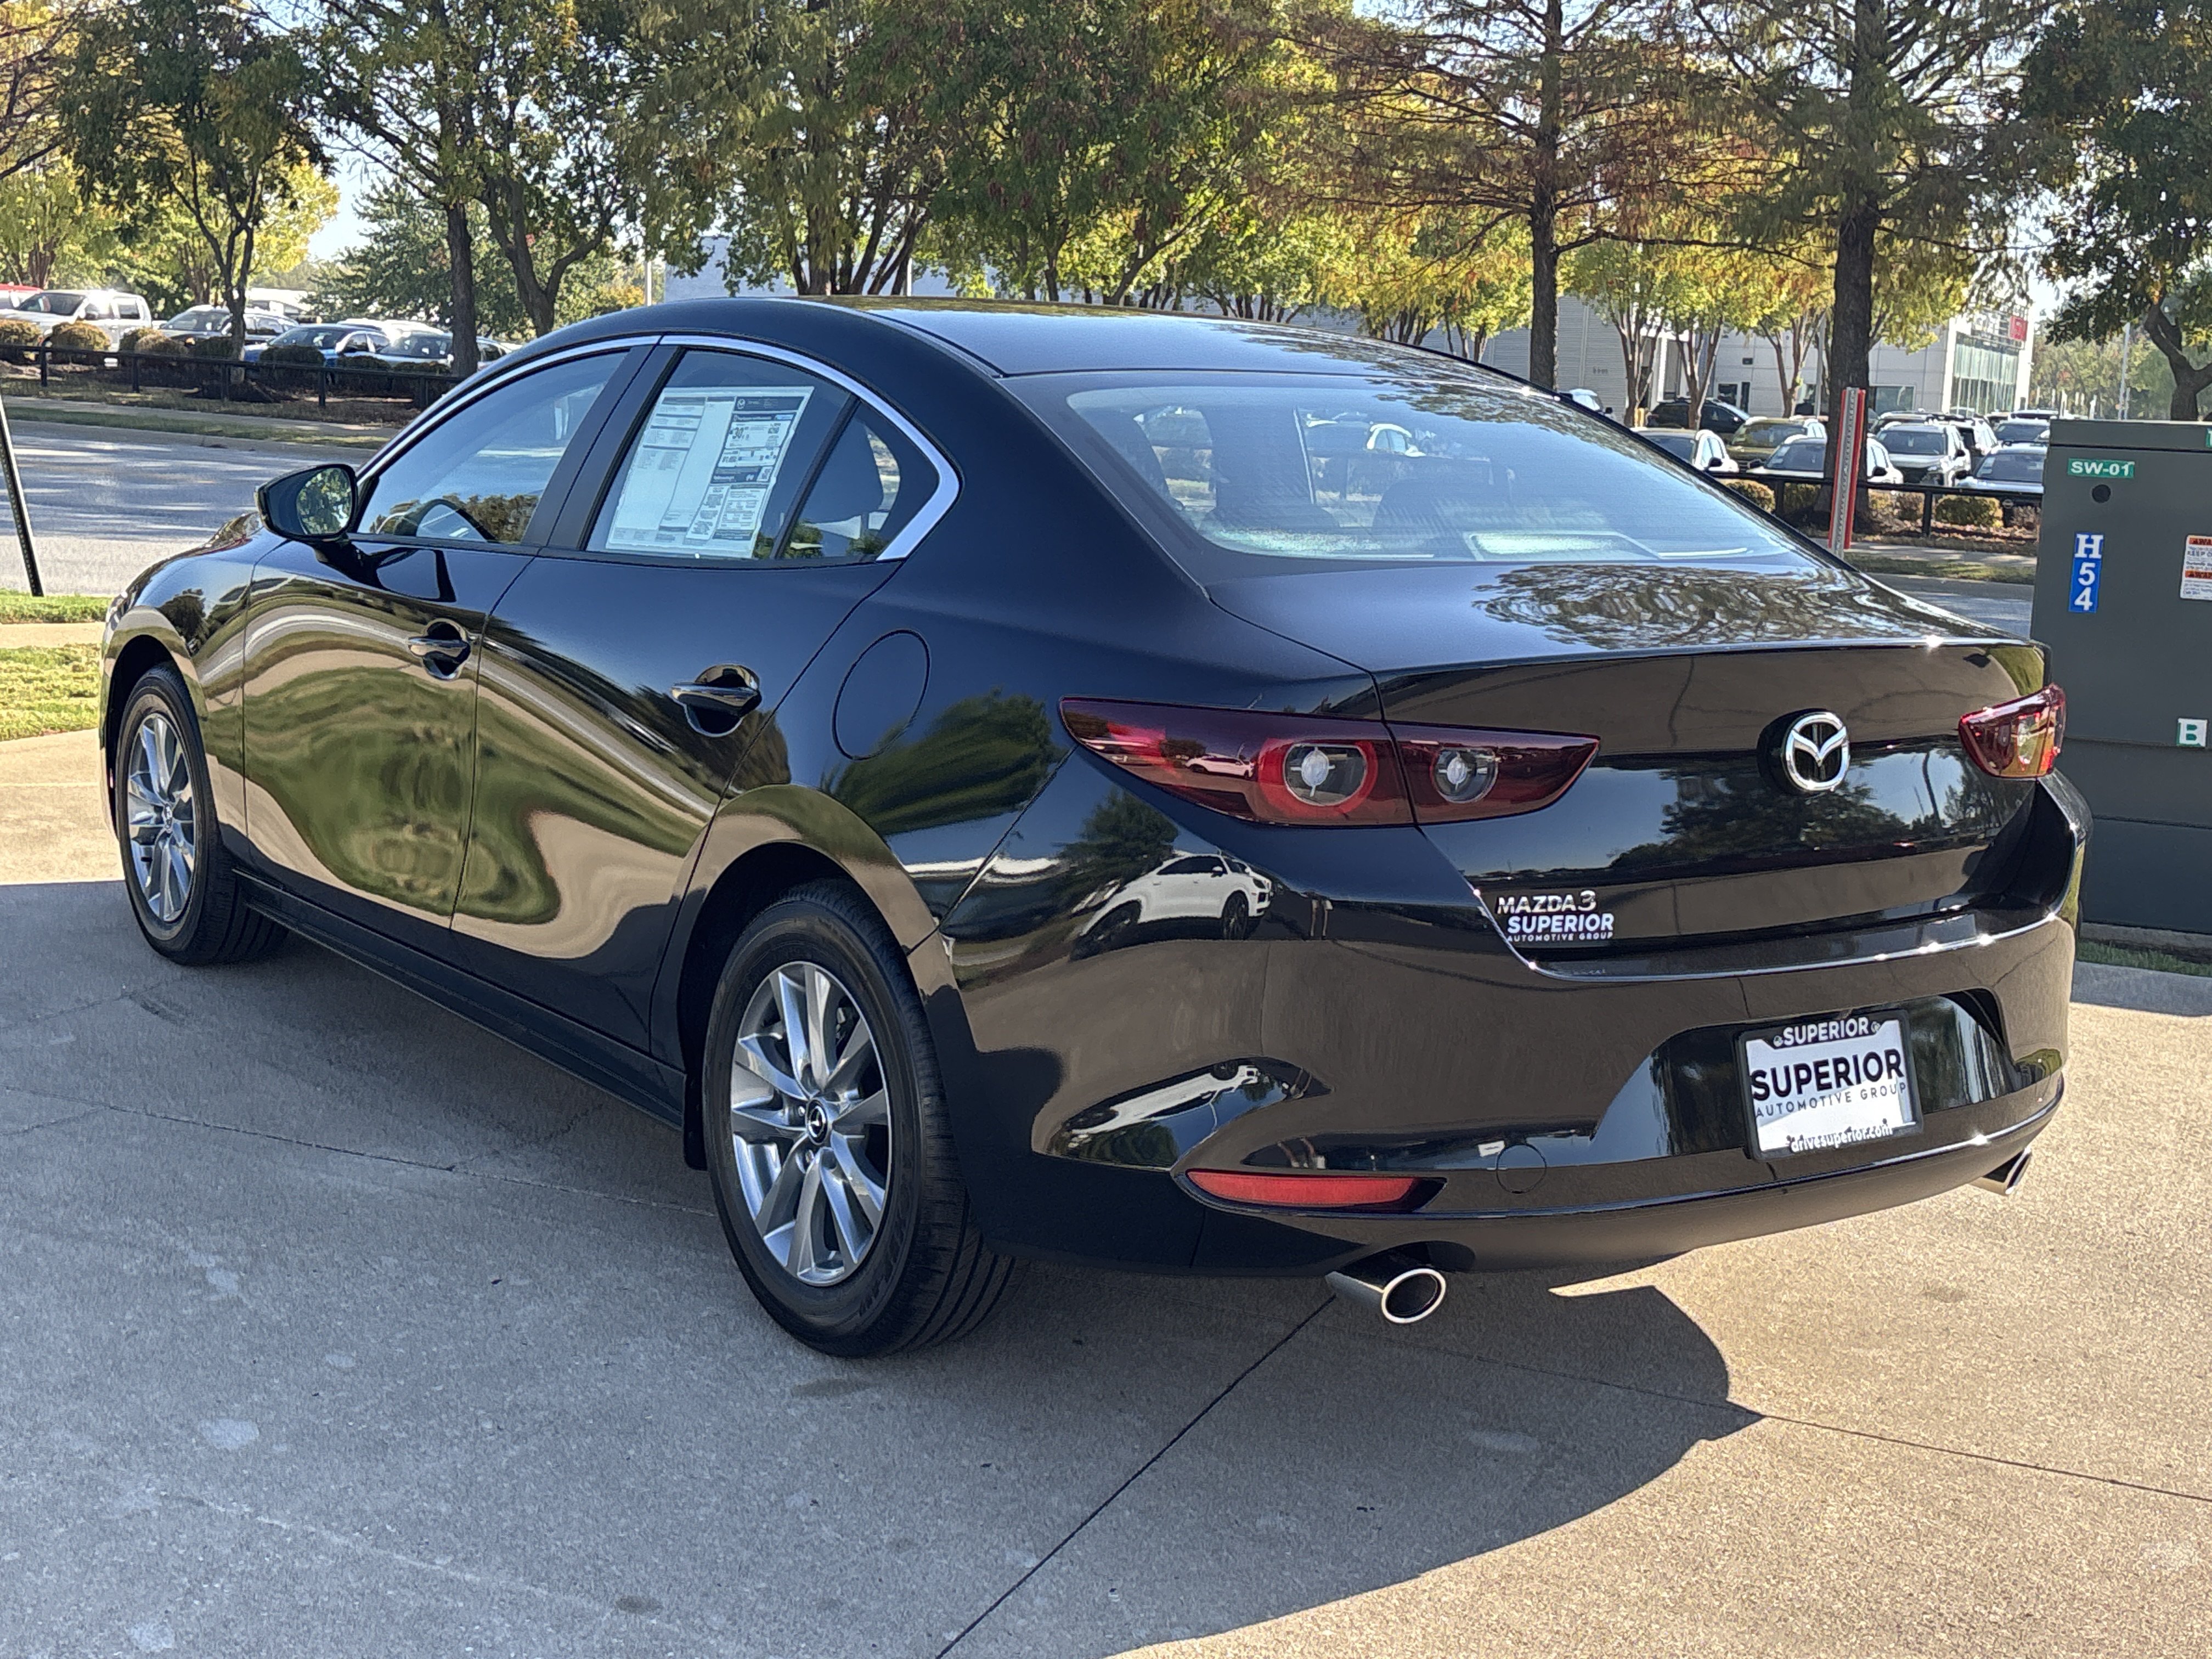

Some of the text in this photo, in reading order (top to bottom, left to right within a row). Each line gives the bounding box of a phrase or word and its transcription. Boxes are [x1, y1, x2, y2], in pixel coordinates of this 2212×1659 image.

[2070, 461, 2131, 476] SW-01
[1508, 913, 1615, 933] SUPERIOR
[1508, 932, 1613, 941] AUTOMOTIVE GROUP
[1783, 1017, 1869, 1046] SUPERIOR
[1750, 1048, 1904, 1101] SUPERIOR
[1755, 1082, 1906, 1118] AUTOMOTIVE GROUP
